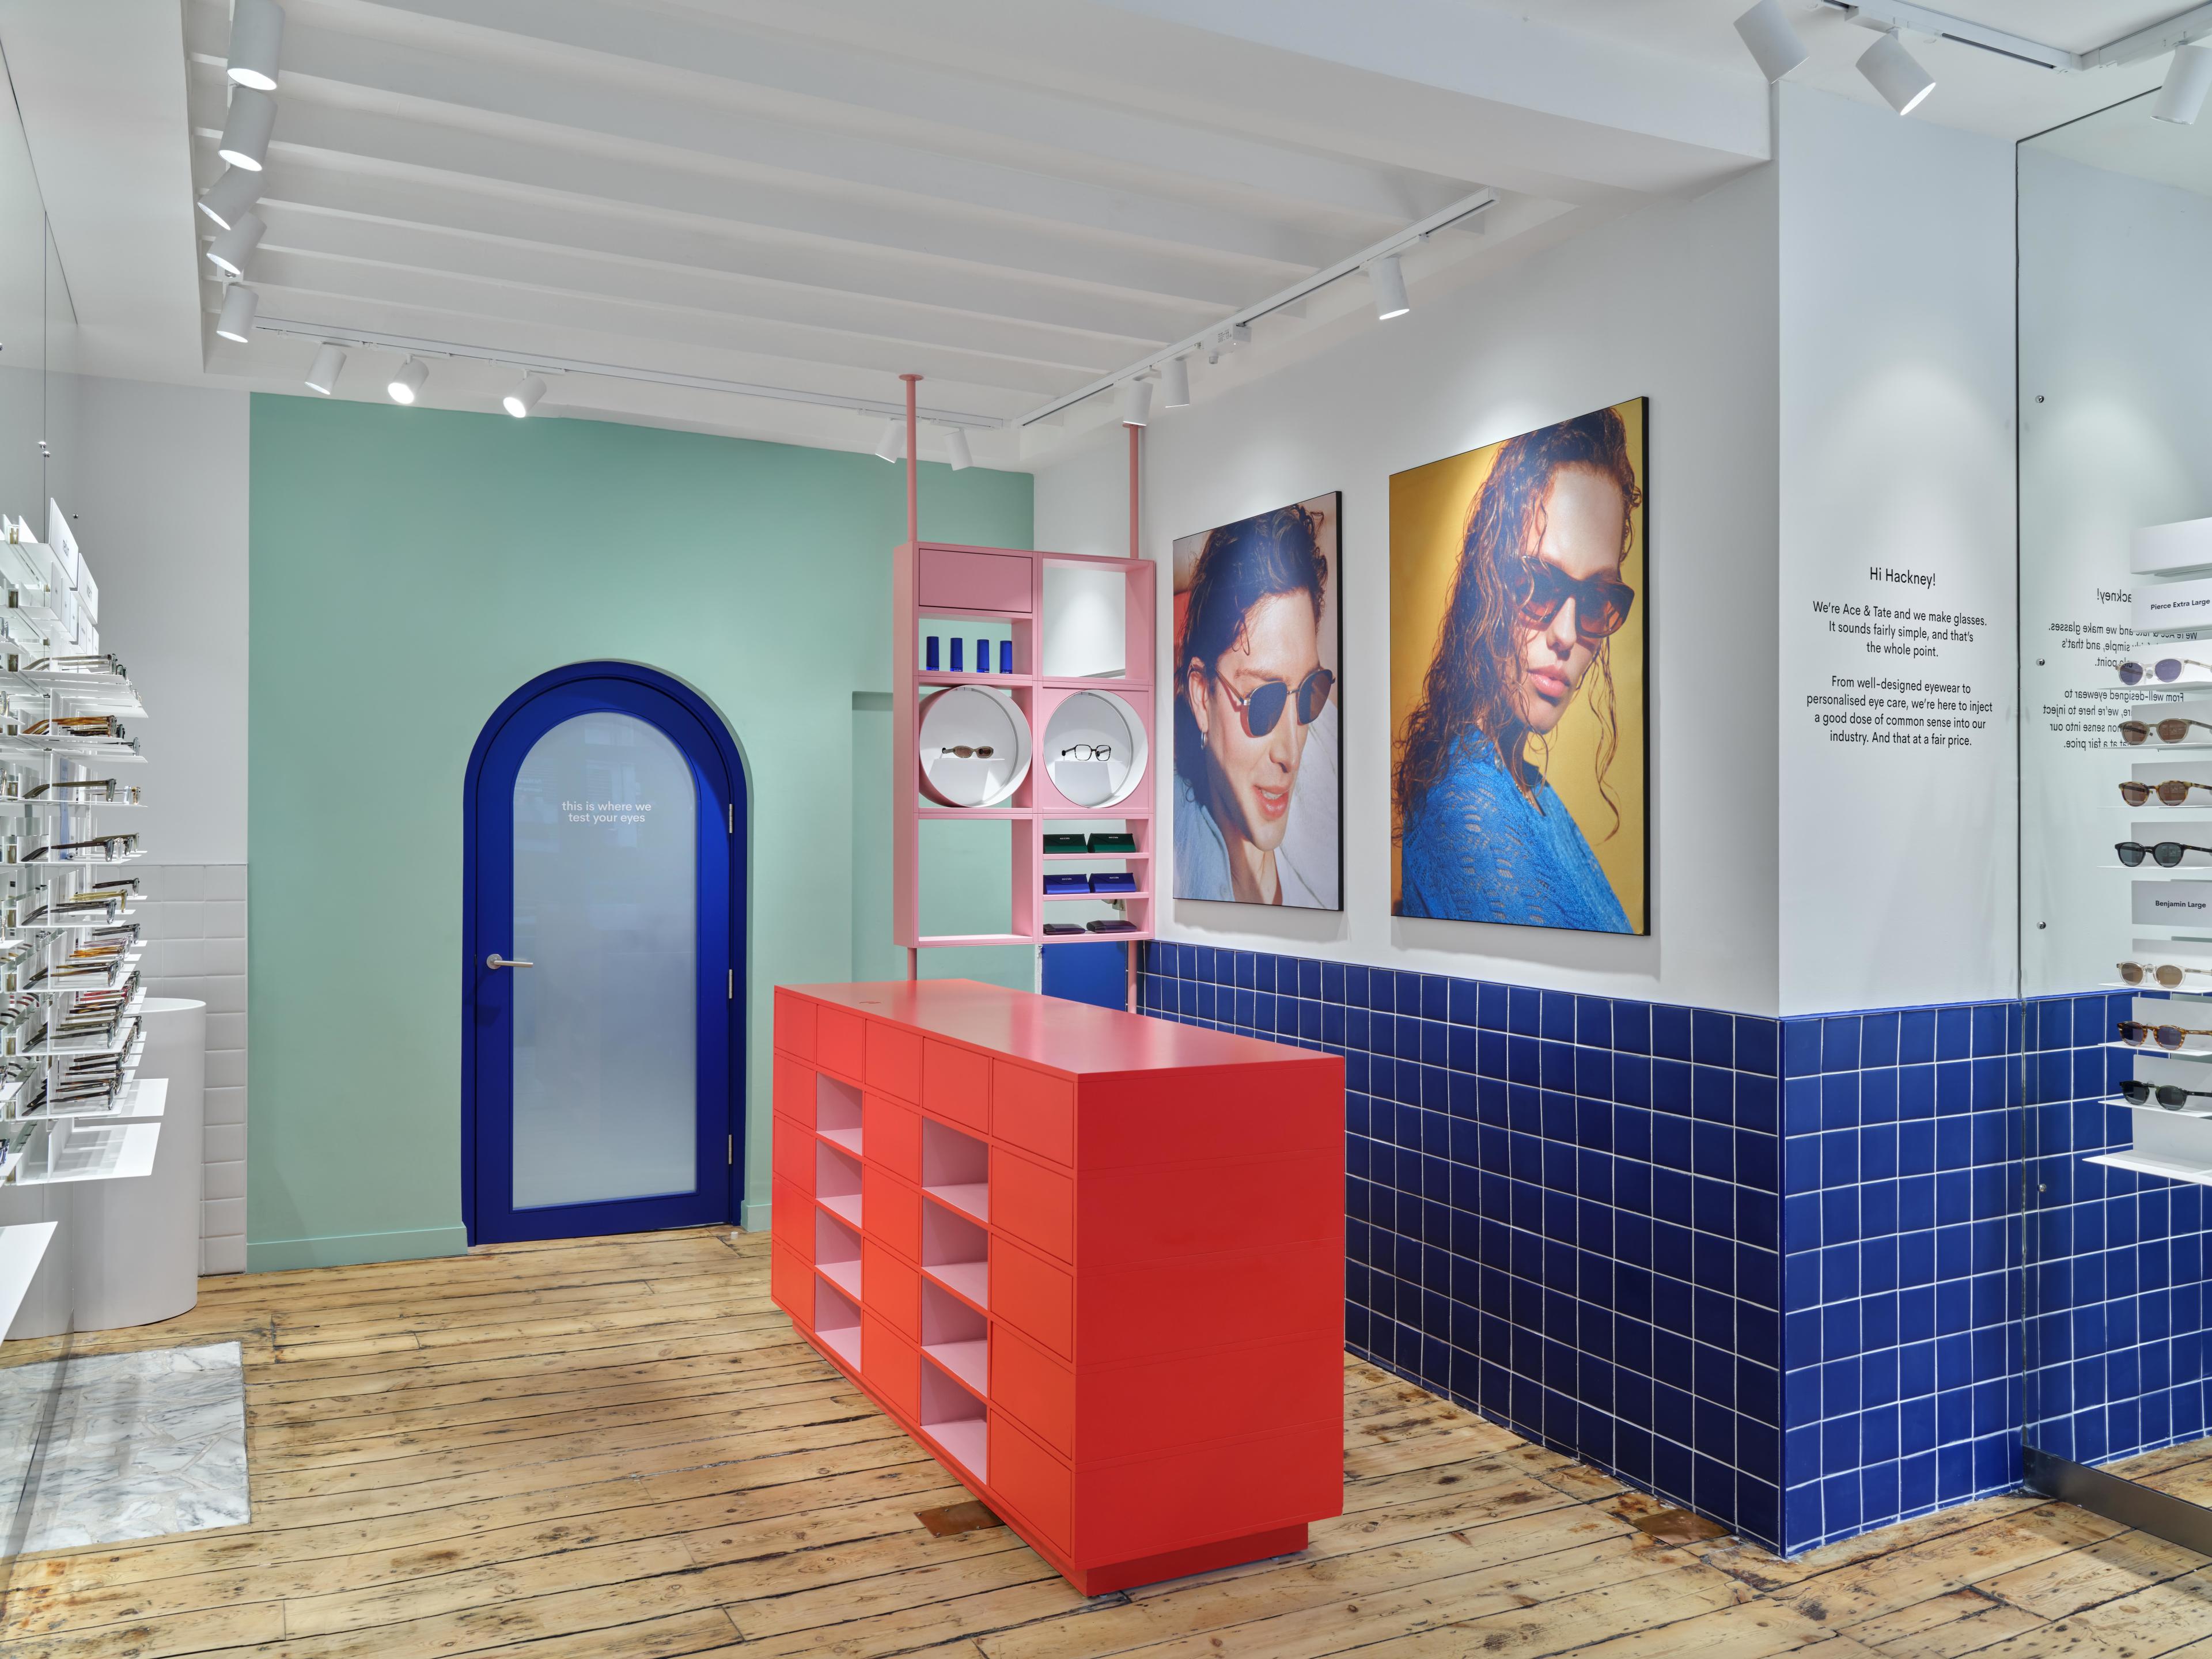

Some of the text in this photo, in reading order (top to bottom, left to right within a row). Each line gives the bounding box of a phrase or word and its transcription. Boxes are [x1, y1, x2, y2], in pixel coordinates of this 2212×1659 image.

[1870, 567, 1935, 589] Hi Hackney!
[1813, 601, 1986, 626] We're Ace & Tate and we make glasses.
[1830, 620, 1973, 642] It sounds fairly simple, and that's
[1866, 641, 1938, 658] the whole point.
[1832, 676, 1971, 694] From well-designed eyewear to
[1807, 694, 1992, 714] personalised eye care, we're here to inject
[1815, 714, 1820, 722] a
[1823, 712, 1846, 726] good
[1850, 713, 1872, 724] dose
[1875, 714, 1884, 725] of
[1887, 717, 1923, 726] common
[1927, 719, 1951, 727] sense
[1954, 717, 1969, 728] into
[1831, 730, 1868, 745] industry.
[1872, 732, 1889, 743] And
[1893, 732, 1910, 743] that
[1913, 734, 1921, 744] at
[1931, 733, 1945, 744] fair
[1948, 735, 1971, 748] price.
[562, 801, 582, 810] this
[586, 801, 594, 810] is
[598, 801, 632, 811] where
[568, 813, 645, 824] test your eyes
